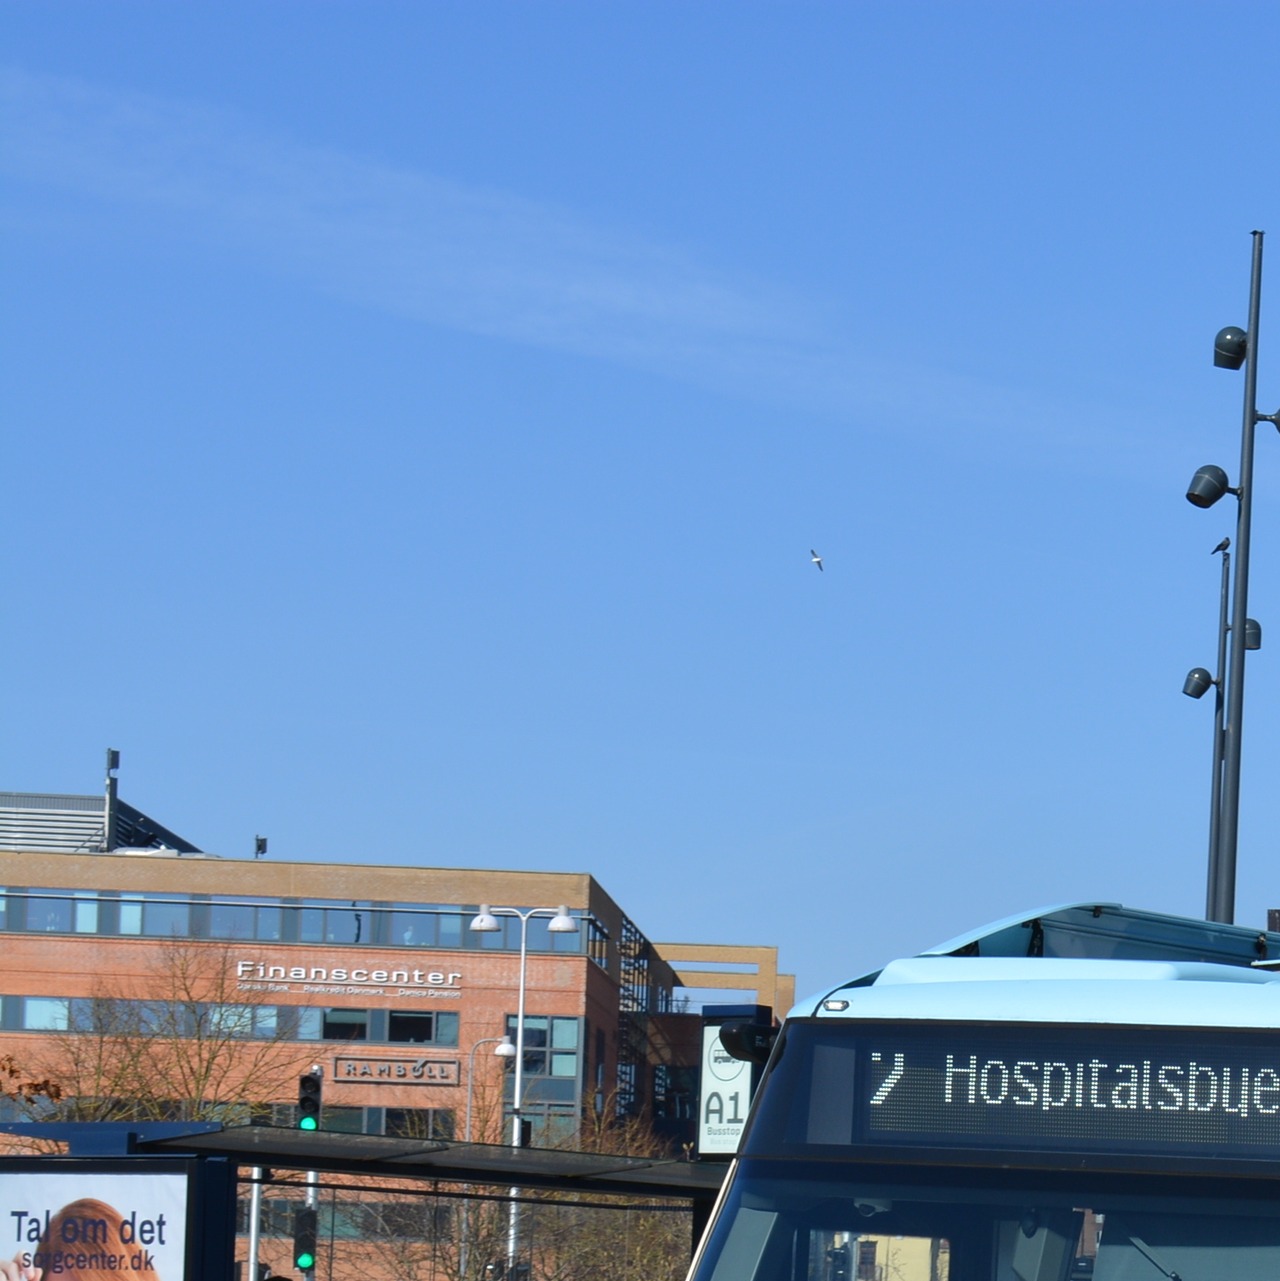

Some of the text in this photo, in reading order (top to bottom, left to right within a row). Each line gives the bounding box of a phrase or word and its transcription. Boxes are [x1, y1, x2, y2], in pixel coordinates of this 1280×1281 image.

[237, 961, 462, 985] Finanscenter
[705, 1091, 744, 1124] A1
[707, 1127, 740, 1136] Busstop
[10, 1209, 166, 1245] Tal om det
[22, 1249, 155, 1274] sorgcenter.dk
